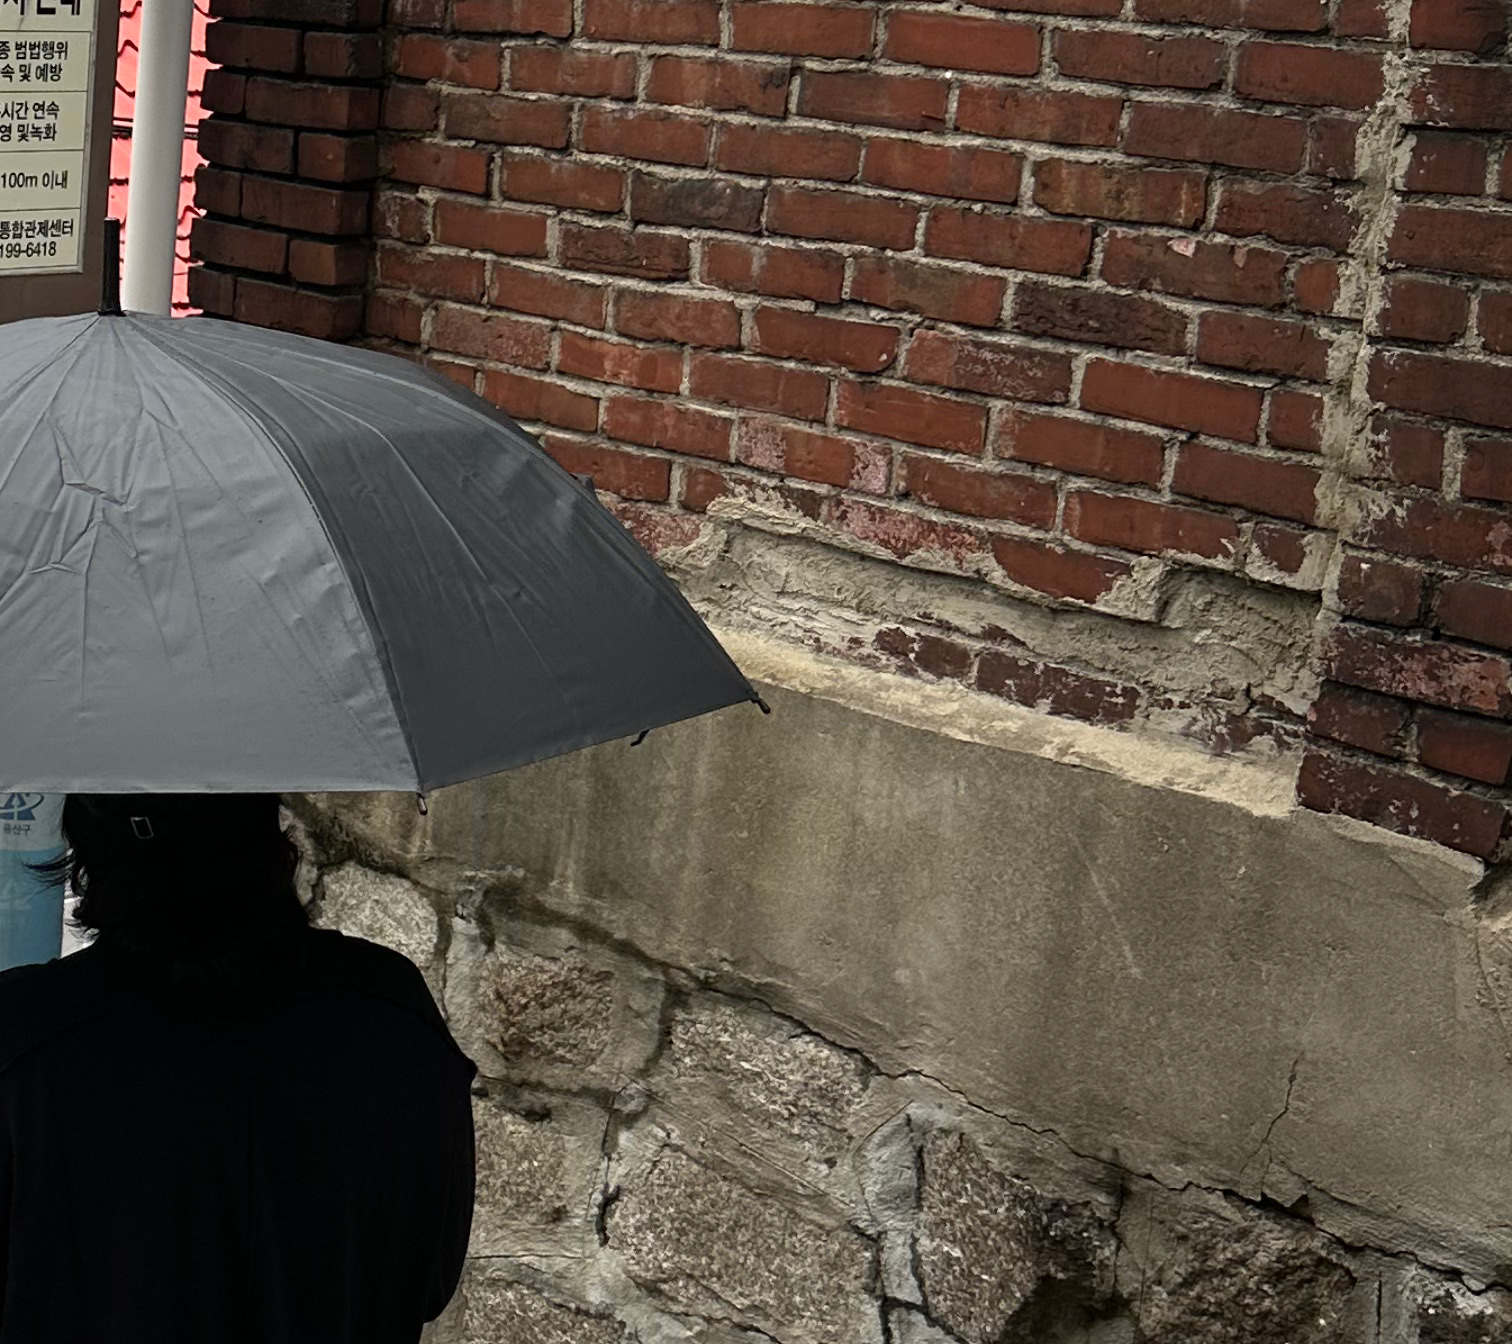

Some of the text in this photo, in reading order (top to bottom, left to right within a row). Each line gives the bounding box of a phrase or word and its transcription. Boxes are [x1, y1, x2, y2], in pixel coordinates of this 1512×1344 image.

[15, 40, 68, 60] 범법행위
[18, 63, 32, 82] 및
[35, 63, 63, 82] 예방
[32, 100, 60, 120] 연속
[0, 172, 38, 188] 100m
[42, 170, 68, 190] 이내
